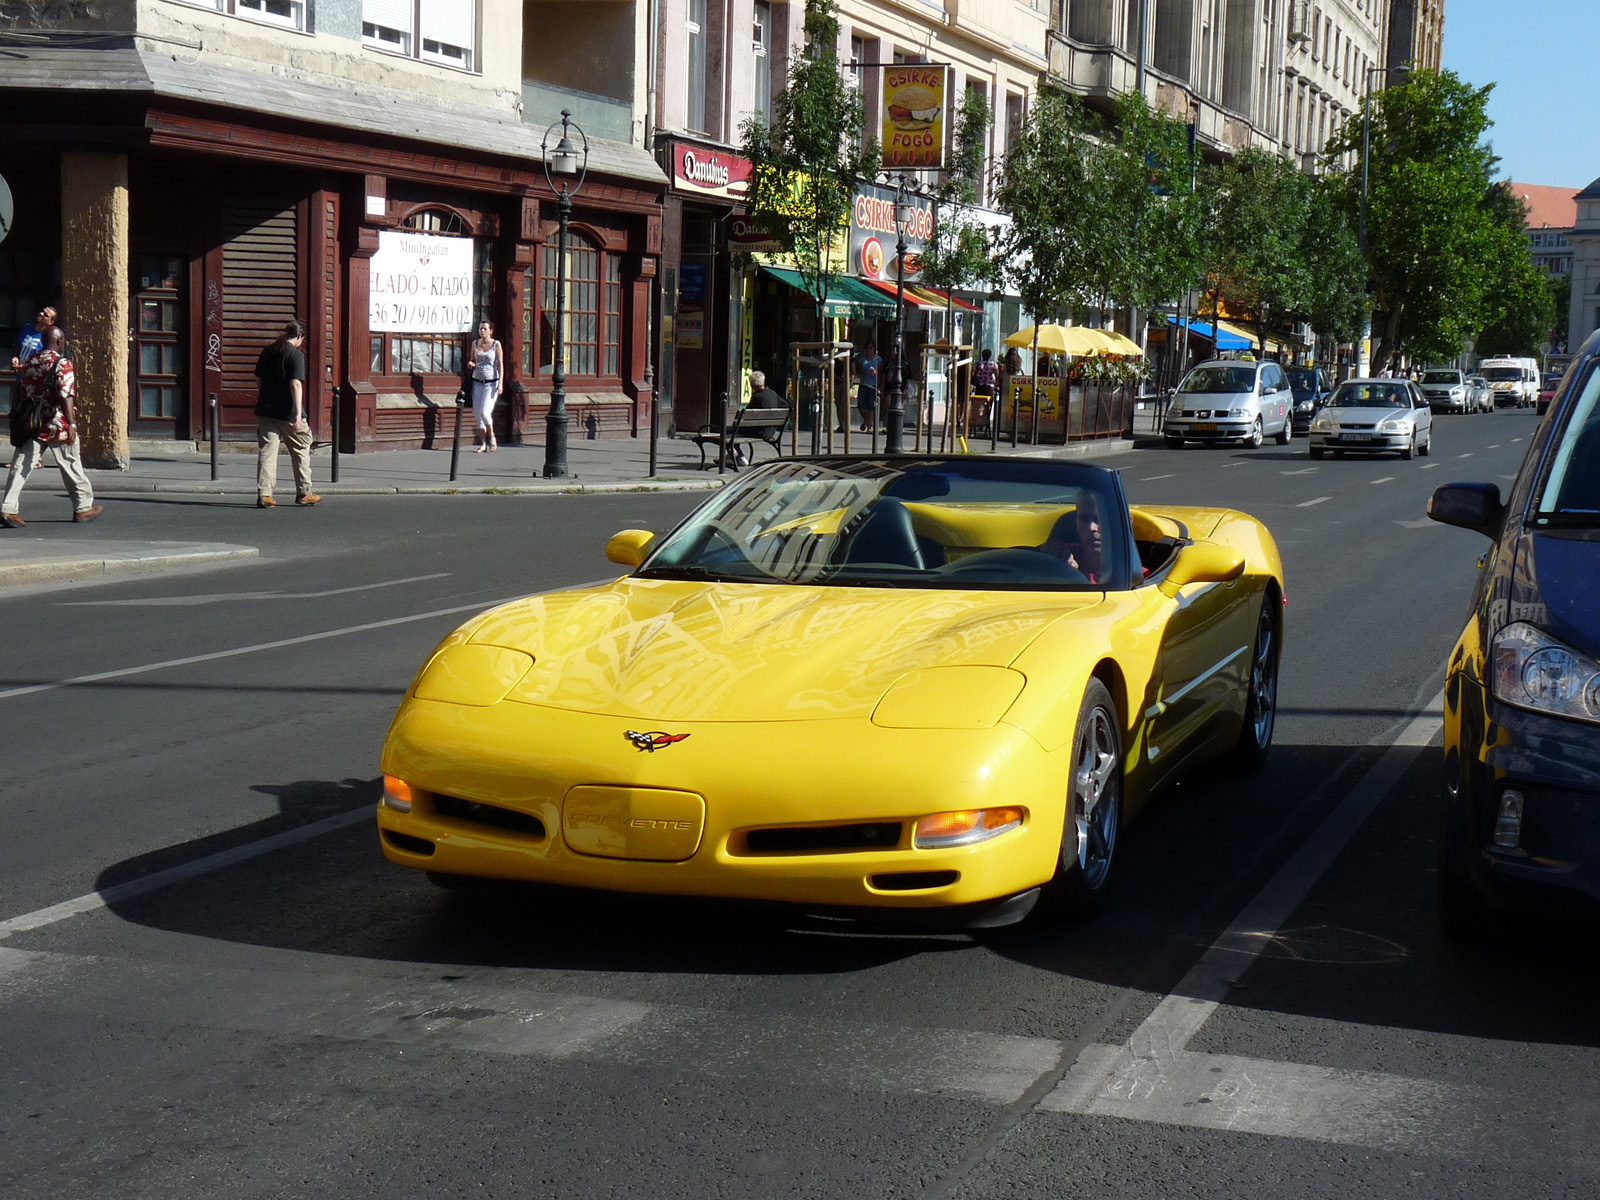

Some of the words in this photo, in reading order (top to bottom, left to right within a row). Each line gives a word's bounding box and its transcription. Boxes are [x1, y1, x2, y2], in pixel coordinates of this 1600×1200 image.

[888, 69, 942, 88] CSIRKE-
[892, 130, 934, 147] FOGÓ
[684, 151, 729, 186] Danubius
[856, 194, 896, 234] CSIRKE
[370, 269, 418, 294] ELADÓ
[430, 271, 470, 297] KIADÓ
[392, 303, 407, 324] 20
[418, 305, 438, 325] 916
[441, 305, 454, 324] 70
[457, 305, 470, 325] 02
[743, 297, 751, 397] PIZZA
[570, 812, 693, 831] CORVETTE
